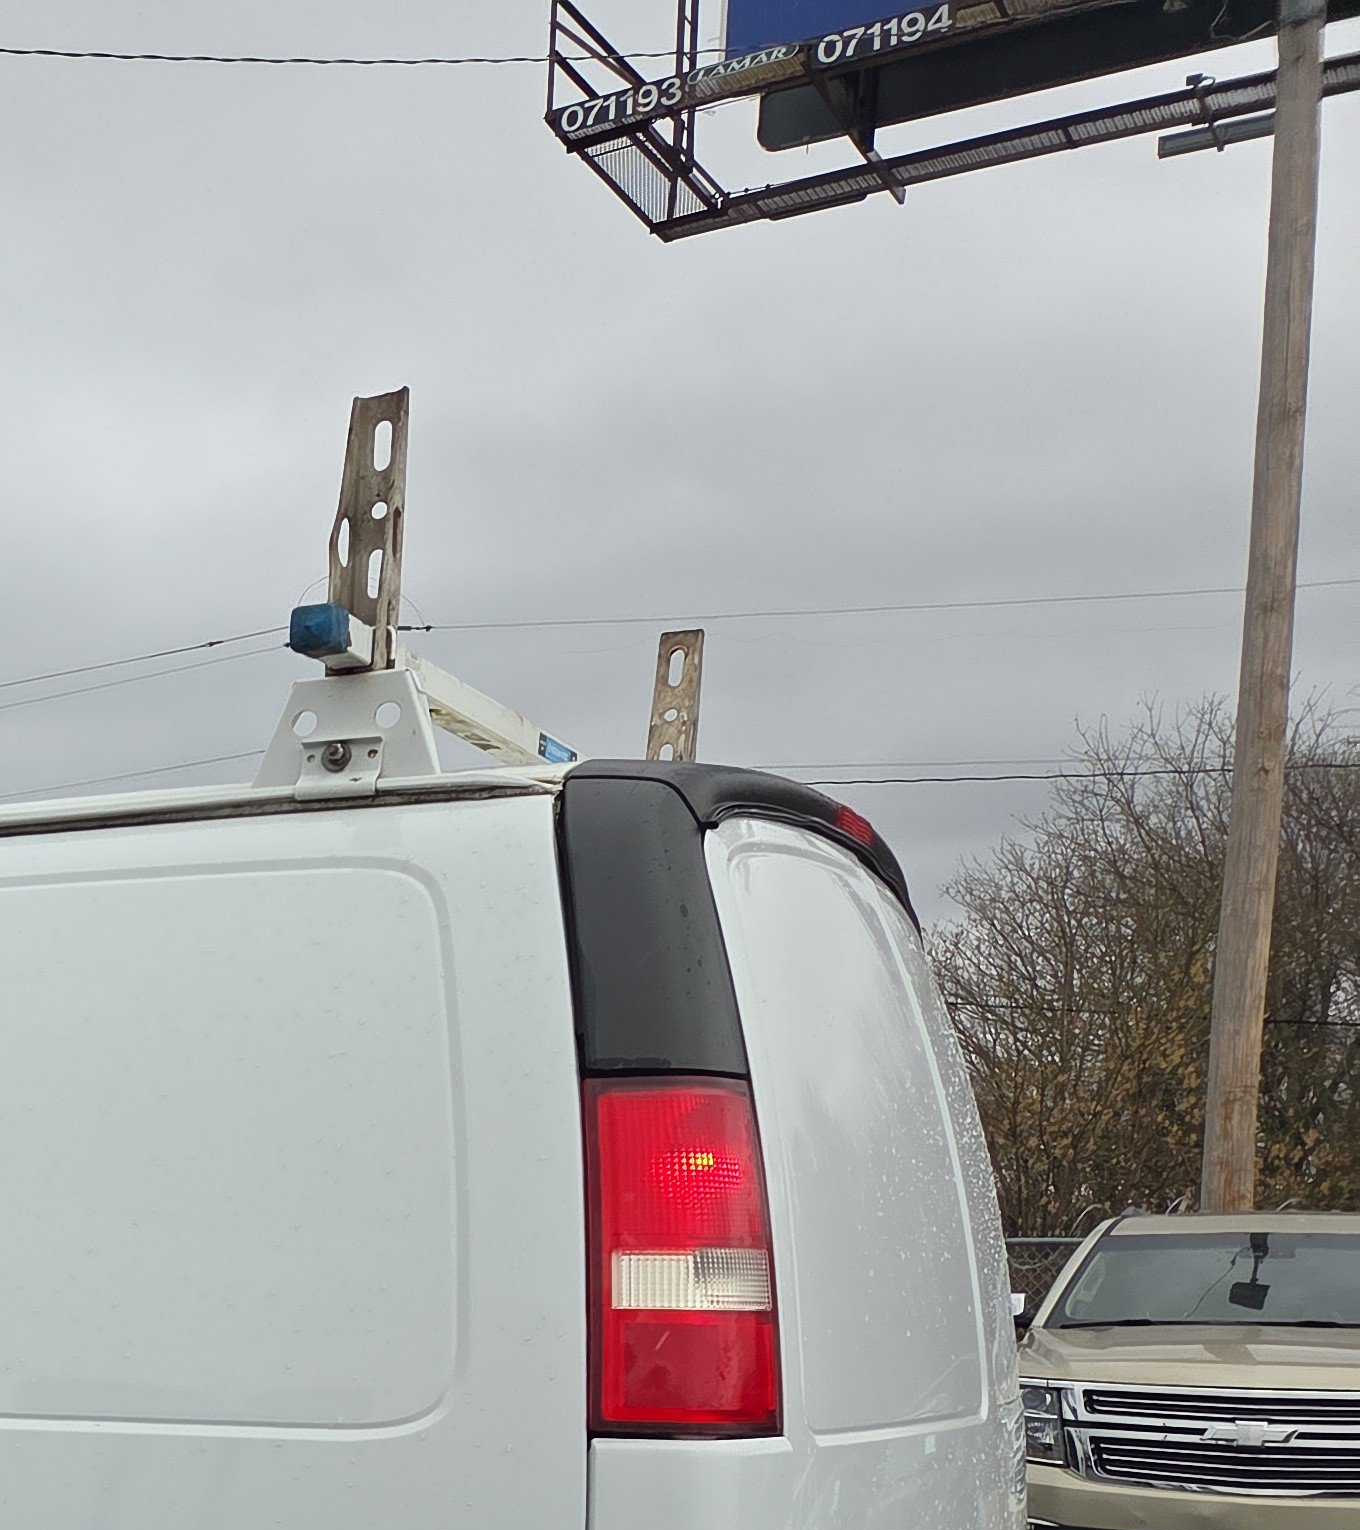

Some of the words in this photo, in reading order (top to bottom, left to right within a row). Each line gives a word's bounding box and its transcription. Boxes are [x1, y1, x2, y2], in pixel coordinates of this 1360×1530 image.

[817, 4, 953, 64] 071194
[694, 46, 788, 84] LAMAR
[561, 78, 682, 132] 071193
